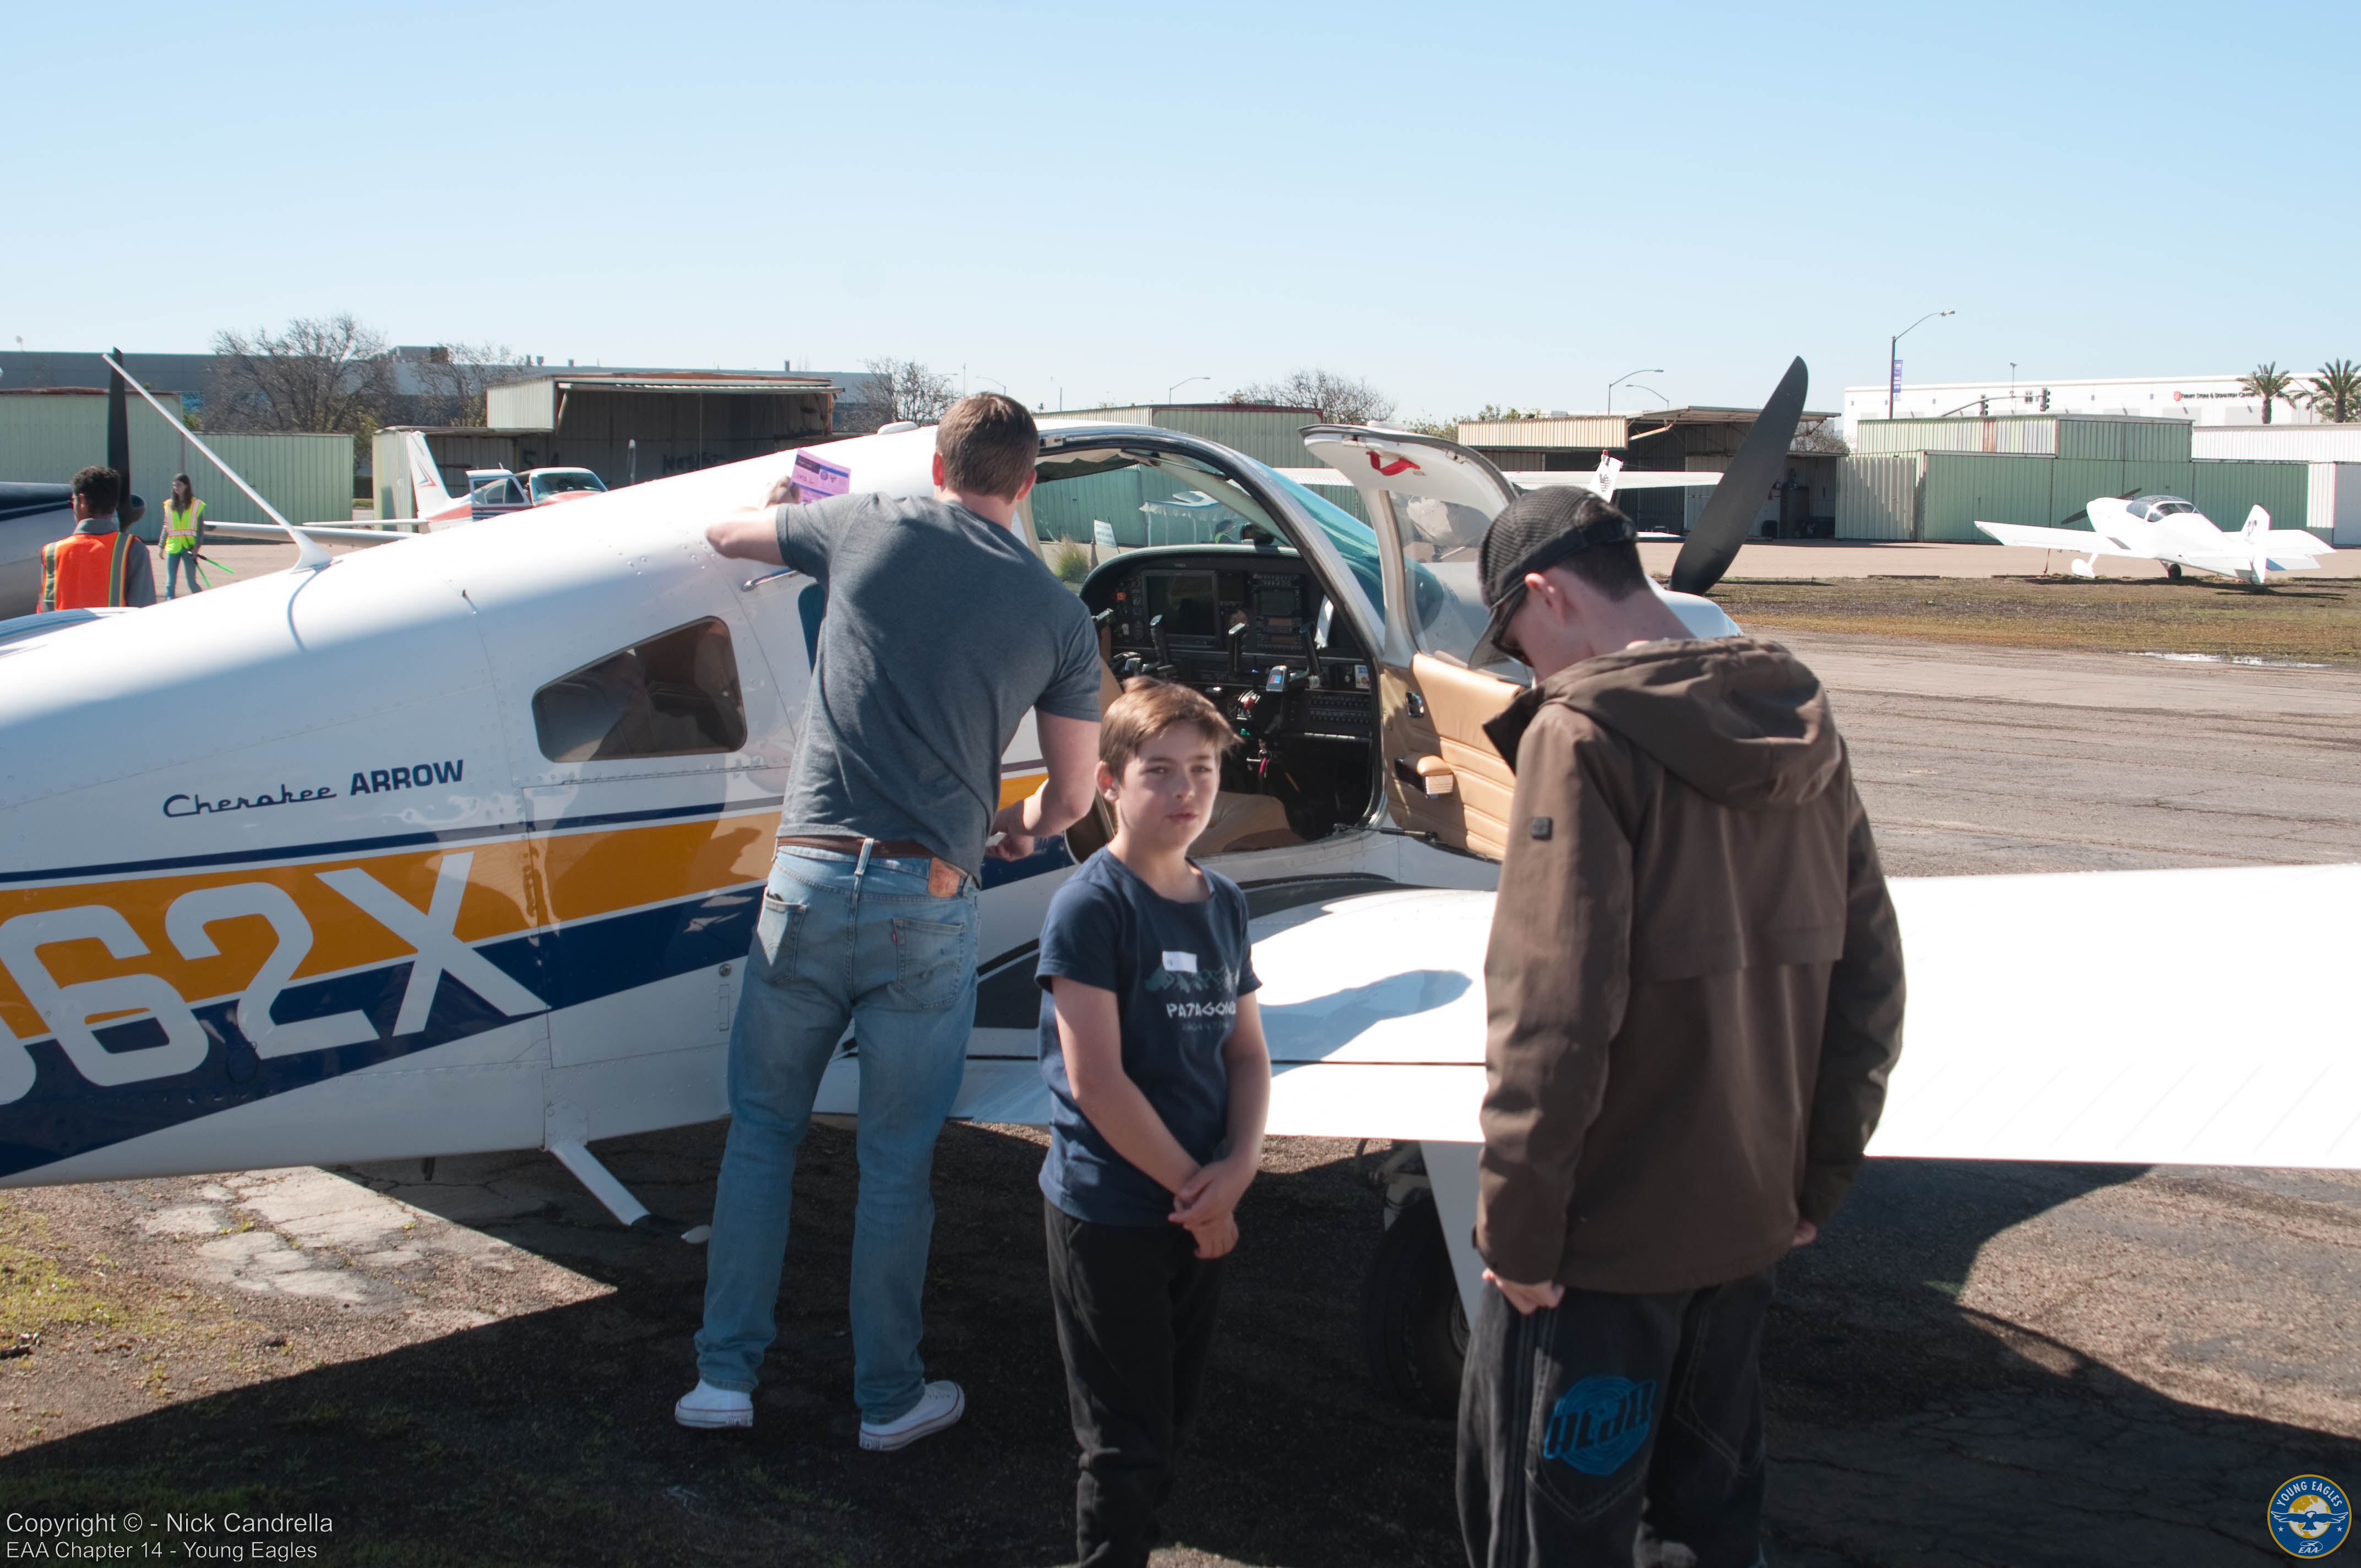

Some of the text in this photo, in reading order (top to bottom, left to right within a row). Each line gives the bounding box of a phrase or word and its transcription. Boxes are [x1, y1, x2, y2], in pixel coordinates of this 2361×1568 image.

[163, 760, 464, 818] Cherokee ARROW
[0, 851, 552, 1106] 62X
